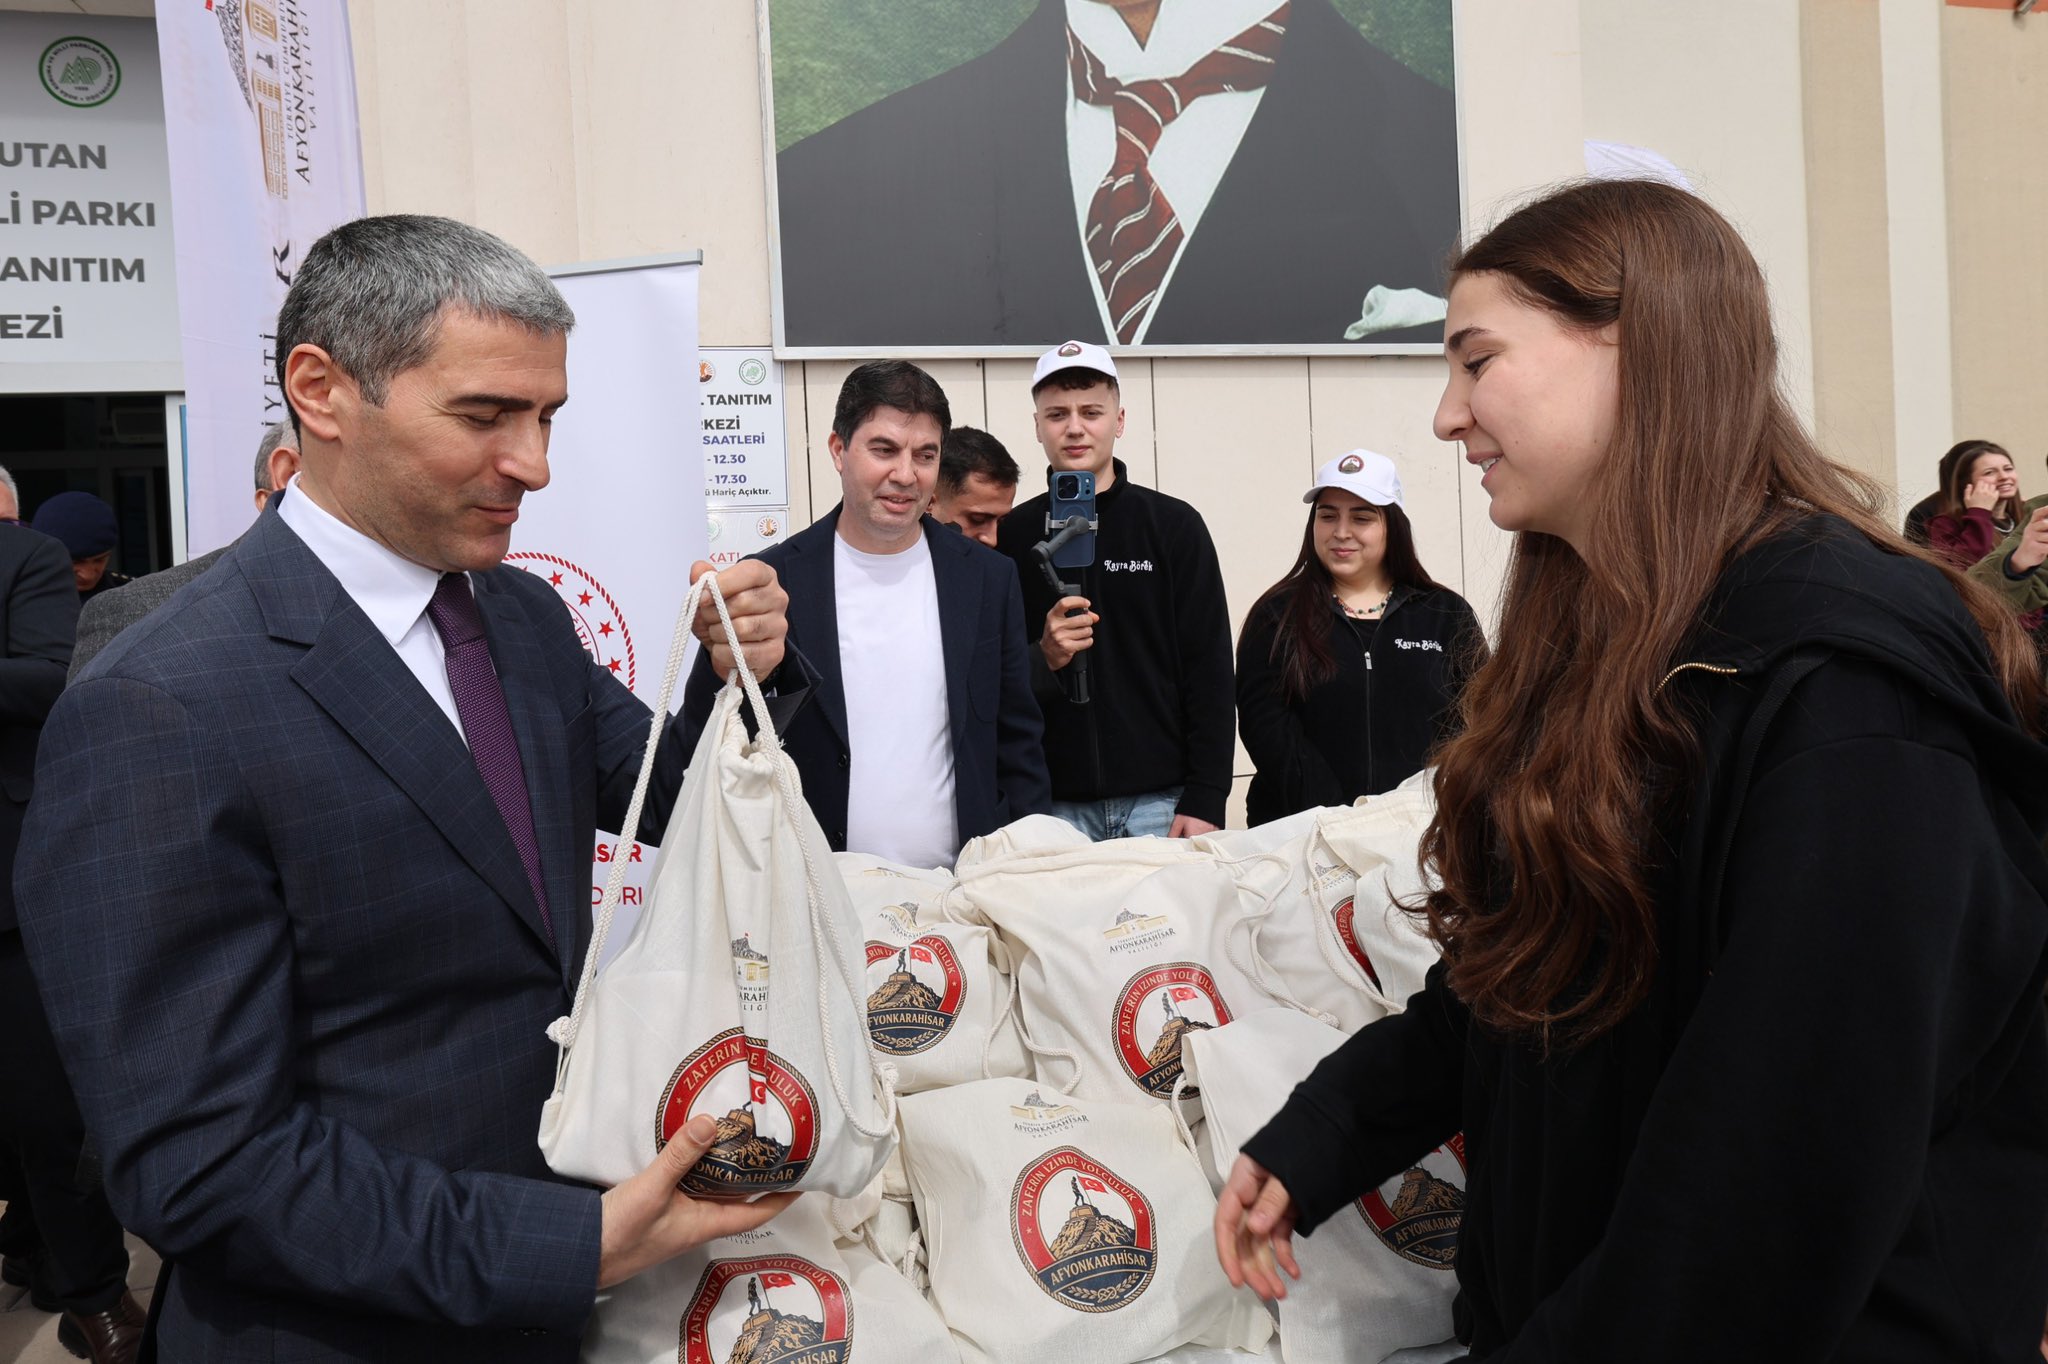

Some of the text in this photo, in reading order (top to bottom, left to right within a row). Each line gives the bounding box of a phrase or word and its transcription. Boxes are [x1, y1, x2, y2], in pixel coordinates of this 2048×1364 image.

[32, 200, 156, 227] PARKI
[0, 257, 145, 283] ANITIM
[0, 305, 63, 339] EZİ
[707, 394, 772, 406] TANITIM
[701, 415, 740, 430] KEZİ
[702, 432, 765, 445] SAATLERİ
[713, 454, 746, 464] 12.30
[715, 474, 747, 484] 17.30
[712, 488, 737, 498] Hariç
[738, 487, 772, 497] Açıktır.
[1104, 560, 1128, 572] Kayra
[1394, 639, 1421, 650] Kayra
[1121, 988, 1141, 1035] ZAFERİN
[1139, 972, 1169, 992] İZİNDE
[684, 1041, 741, 1092] ZAFERİN
[1021, 1154, 1138, 1217] ZAFERİN İZİNDE YOLCULUK
[1050, 1250, 1148, 1286] AFYONKARAHİSAR
[691, 1260, 831, 1345] ZAFERİN İZİNDE YOLCULUK
